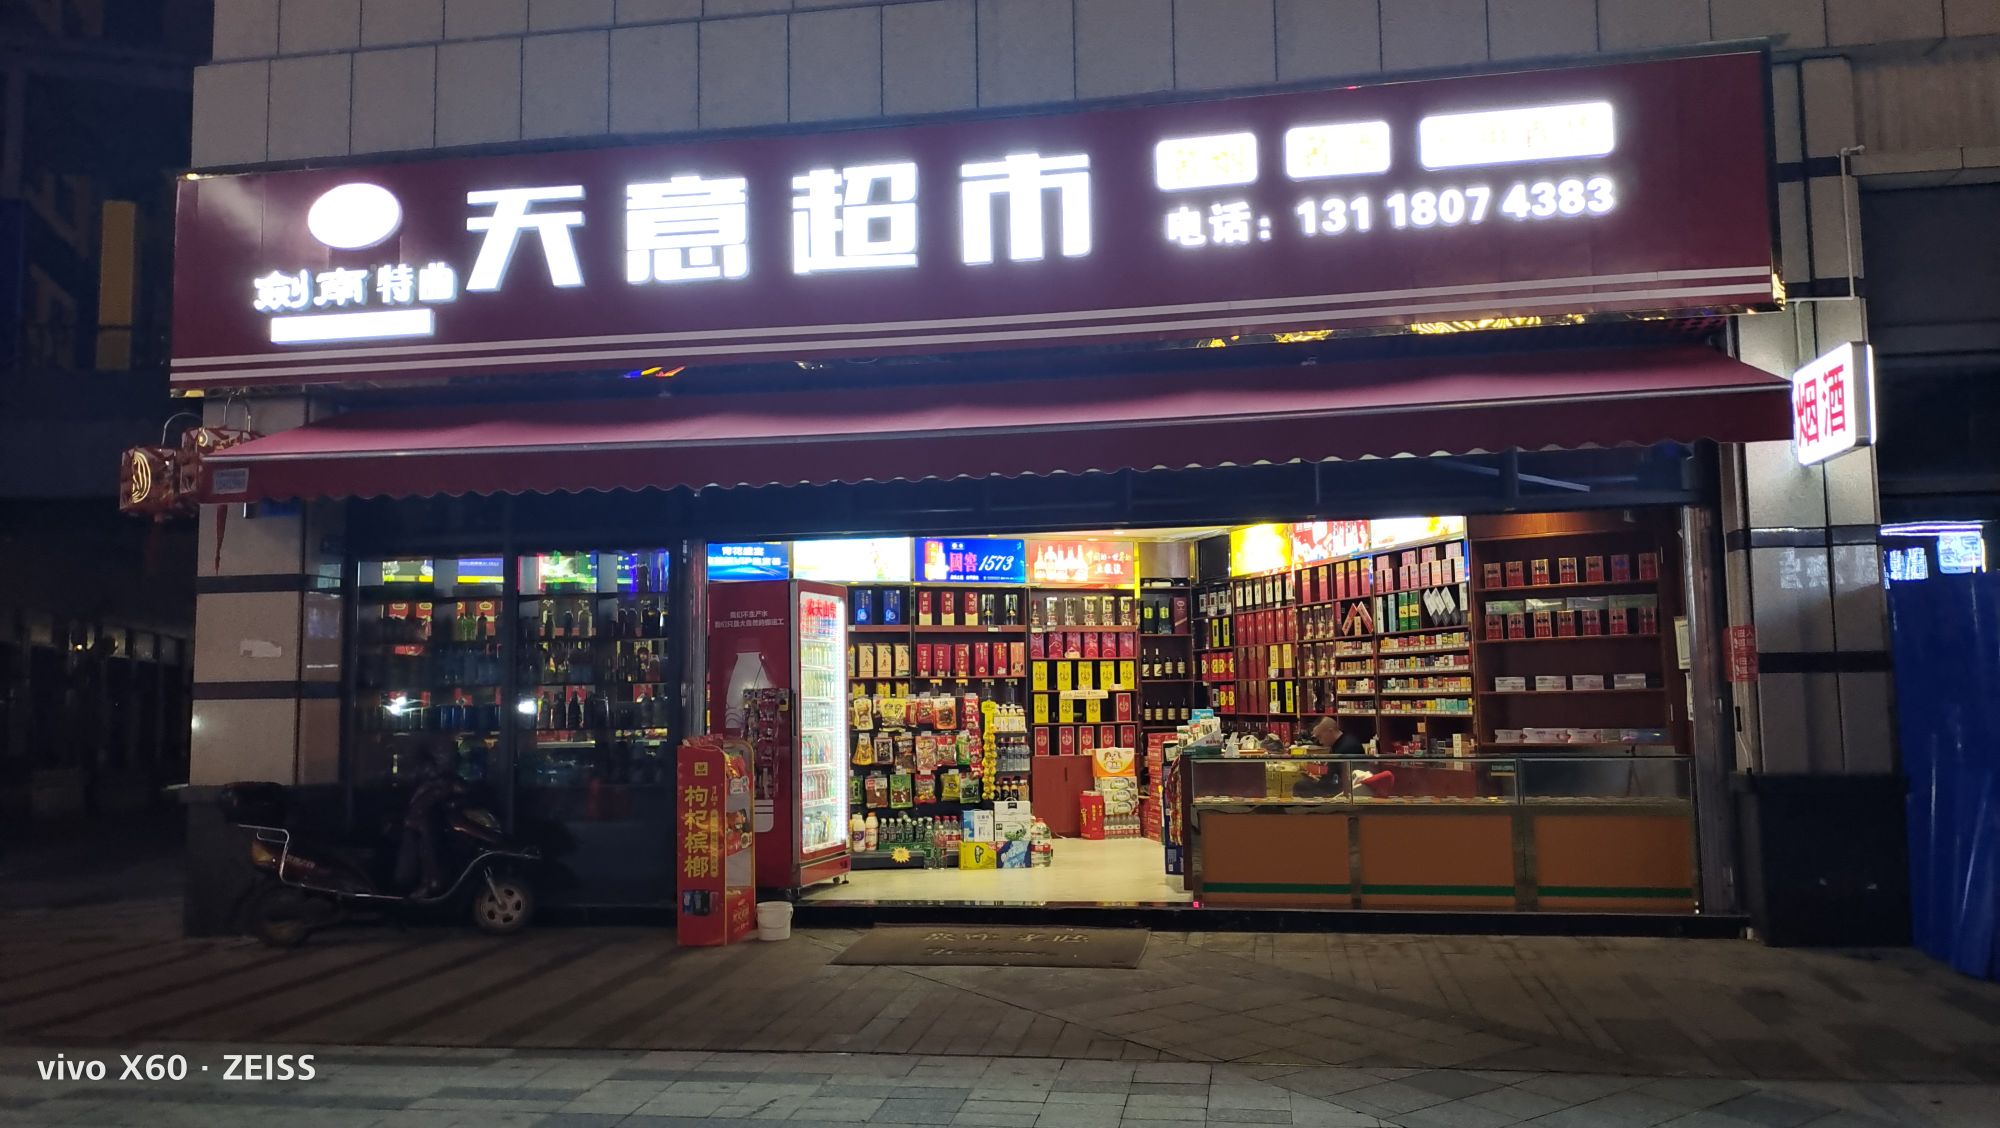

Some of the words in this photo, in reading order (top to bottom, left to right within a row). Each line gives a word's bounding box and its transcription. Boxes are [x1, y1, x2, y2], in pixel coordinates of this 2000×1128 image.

[465, 152, 1093, 291] 天意超市
[1297, 195, 1373, 238] 131
[1386, 184, 1493, 231] 1807
[1501, 176, 1618, 222] 4383
[1796, 364, 1846, 447] 烟酒
[978, 554, 1015, 572] 1573
[684, 785, 709, 878] 枸杞槟榔
